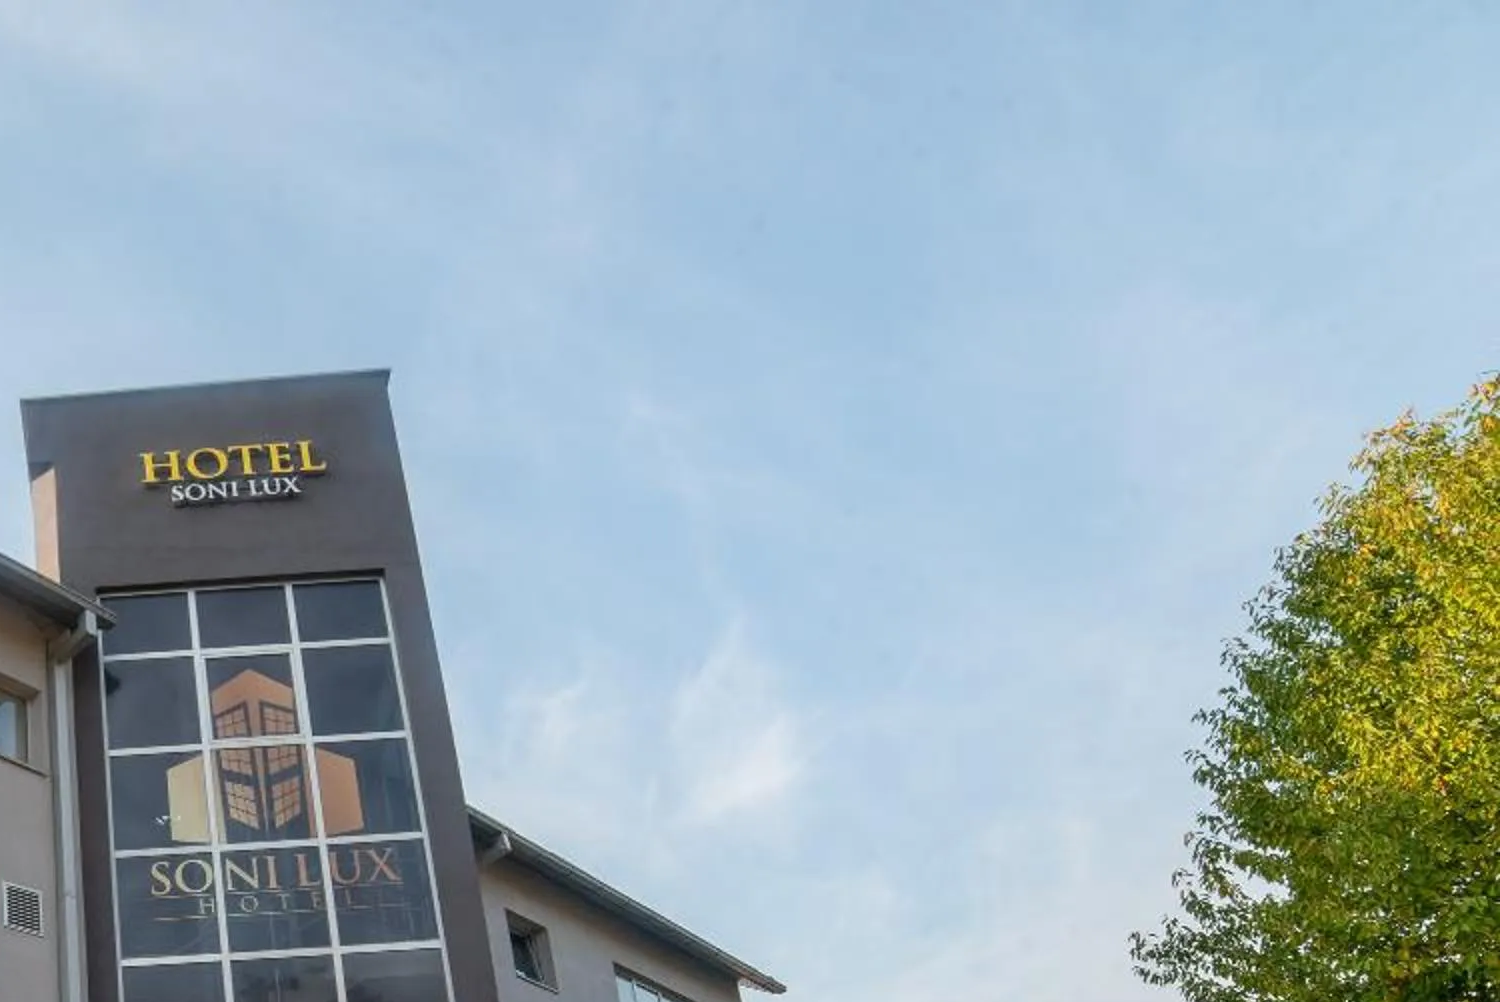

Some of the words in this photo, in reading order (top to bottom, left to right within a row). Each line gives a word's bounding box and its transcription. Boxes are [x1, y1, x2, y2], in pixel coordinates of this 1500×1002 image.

[140, 440, 327, 484] HOTEL
[171, 481, 239, 502] SONI
[249, 476, 302, 497] LUX
[150, 855, 280, 896] SONI
[295, 848, 402, 888] LUX
